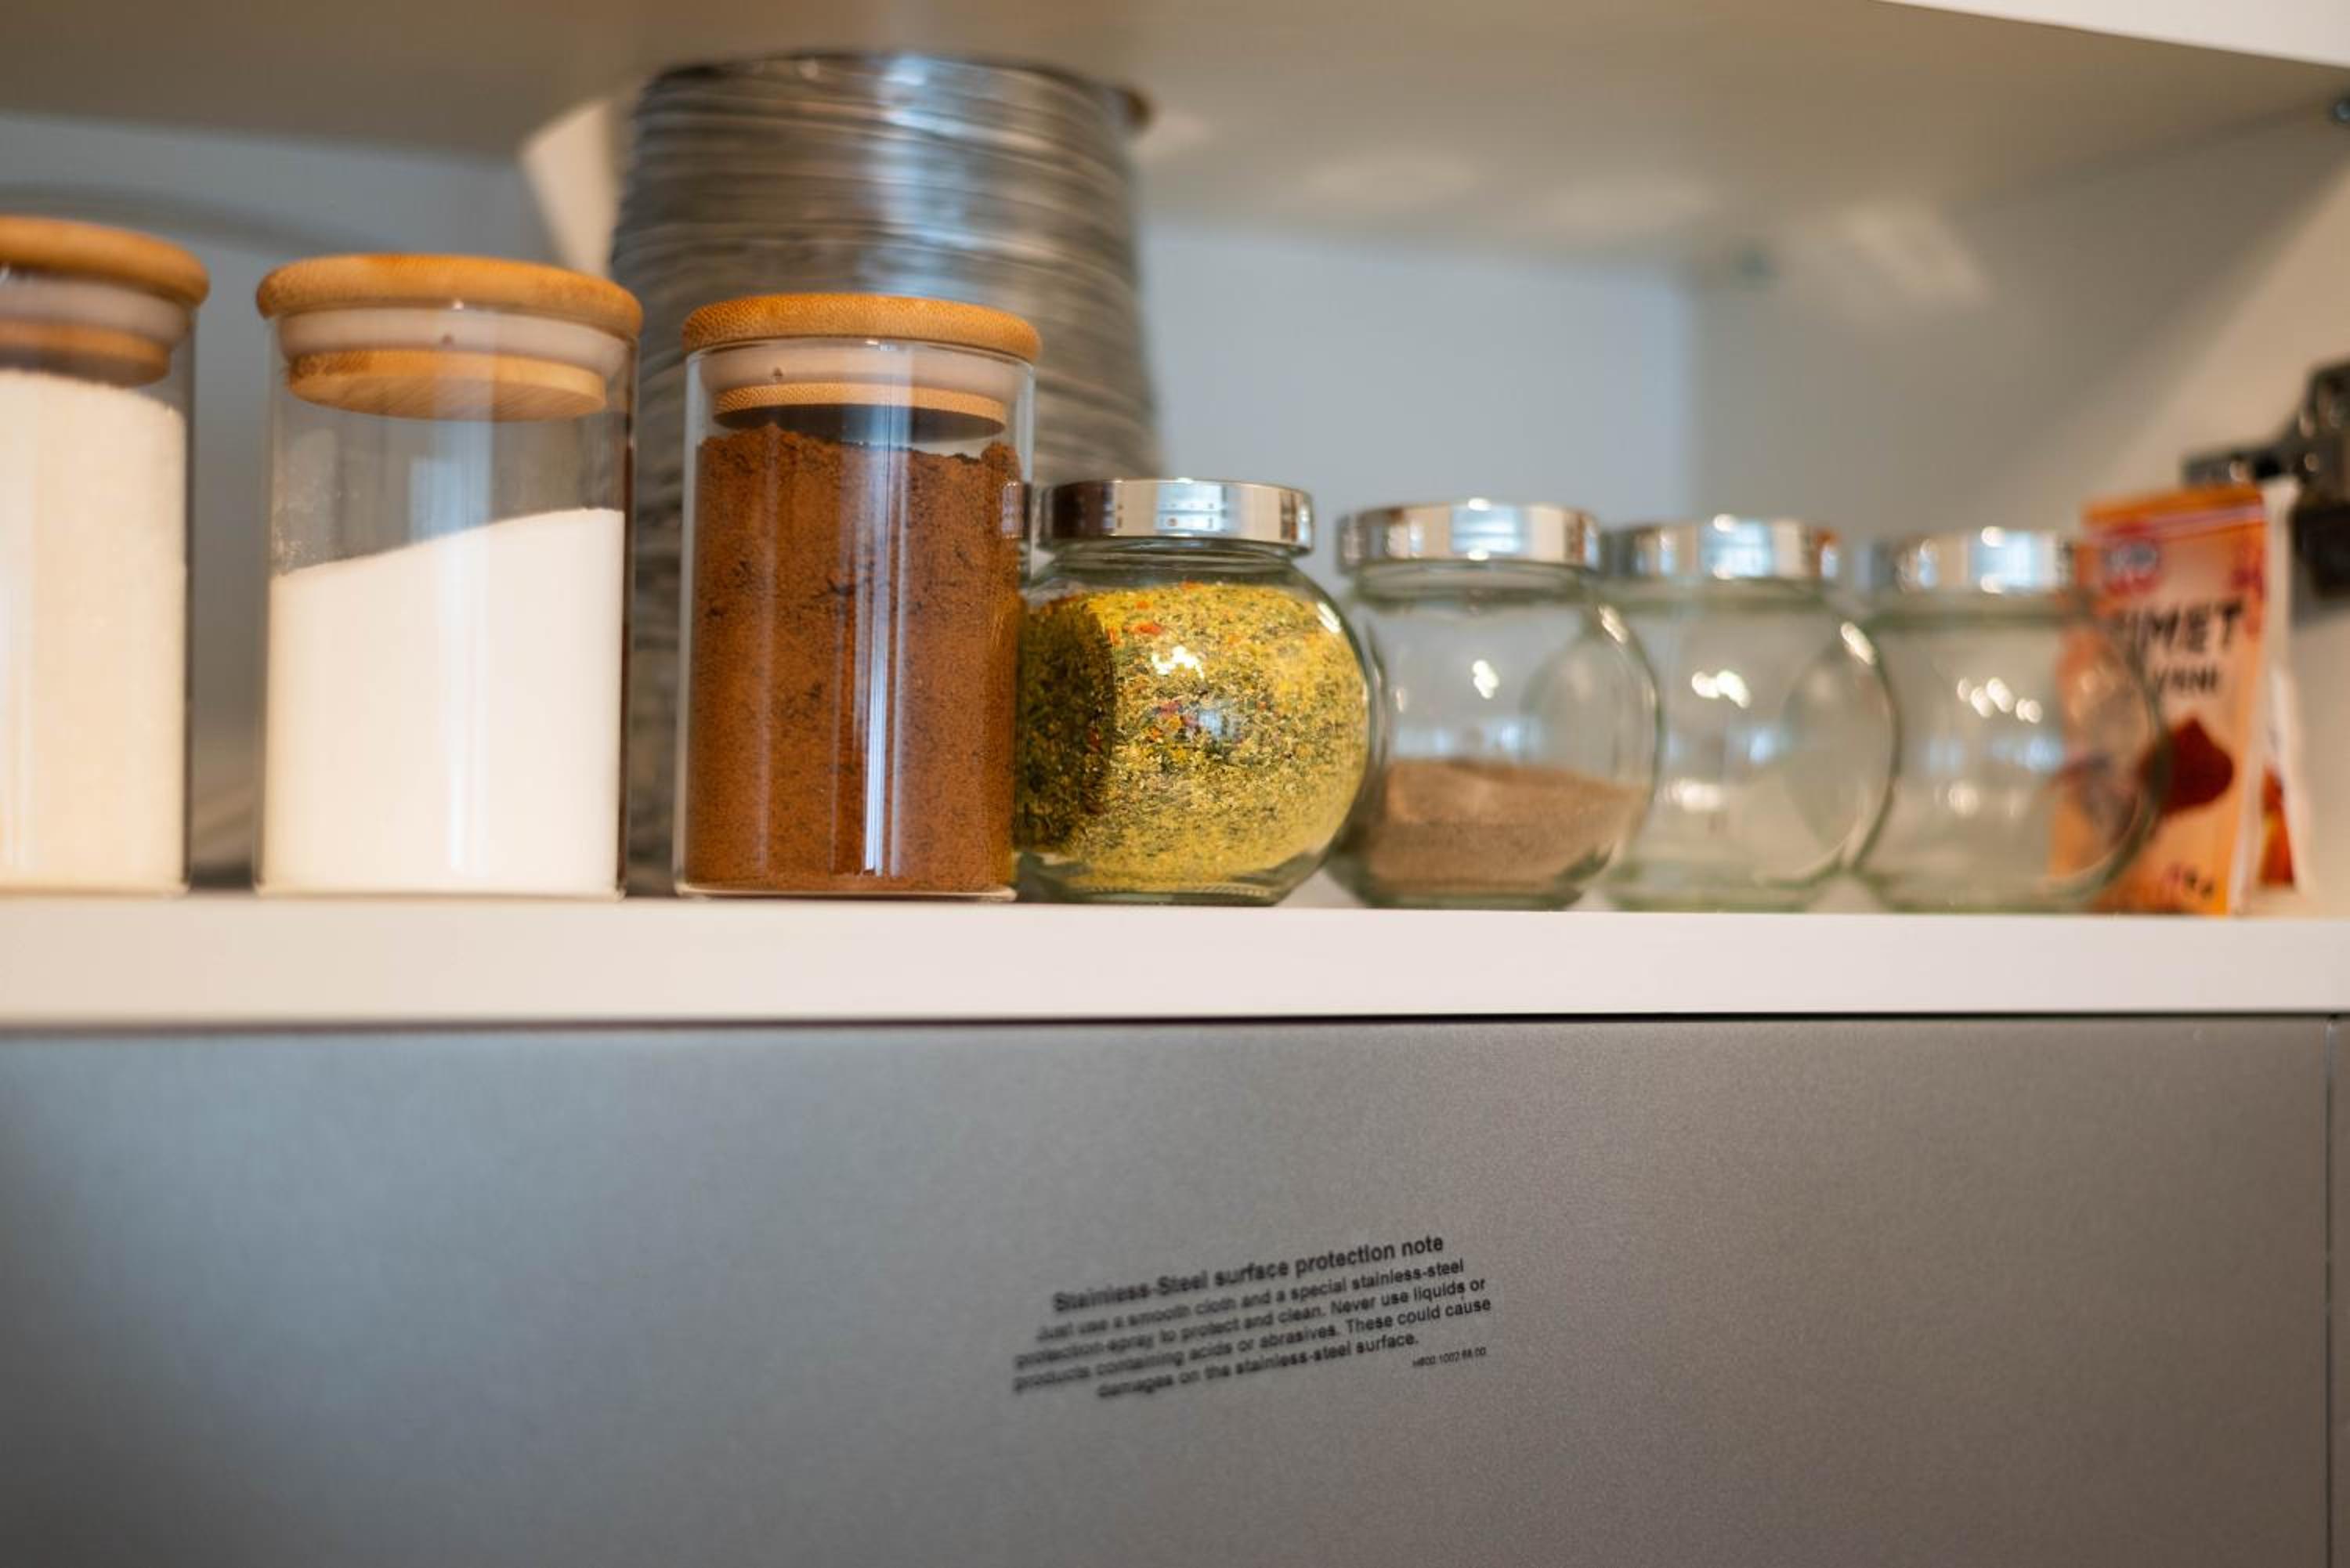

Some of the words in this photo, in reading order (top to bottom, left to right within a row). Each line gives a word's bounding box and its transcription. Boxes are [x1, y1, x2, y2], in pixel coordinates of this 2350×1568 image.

[2114, 598, 2244, 654] IMET
[1214, 1261, 1289, 1288] surface
[1295, 1245, 1396, 1278] protection
[1401, 1236, 1444, 1256] note
[1113, 1317, 1125, 1330] a
[1241, 1290, 1271, 1309] and
[1276, 1291, 1285, 1303] a
[1290, 1277, 1347, 1302] special
[1352, 1258, 1464, 1290] stainless-steel
[1159, 1330, 1177, 1345] to
[1243, 1312, 1274, 1331] and
[1278, 1306, 1326, 1324] clean.
[1331, 1297, 1376, 1314] Never
[1381, 1292, 1409, 1306] use
[1414, 1281, 1466, 1302] liquids
[1470, 1278, 1485, 1292] or
[1178, 1370, 1201, 1385] on
[1204, 1365, 1231, 1381] the
[1235, 1341, 1351, 1375] stainless-steel
[1356, 1334, 1419, 1354] surface.
[1188, 1342, 1233, 1361] acids
[1237, 1339, 1254, 1353] or
[1260, 1325, 1340, 1349] abrasives.
[1345, 1316, 1393, 1333] These
[1397, 1306, 1441, 1325] could
[1445, 1299, 1491, 1317] cause
